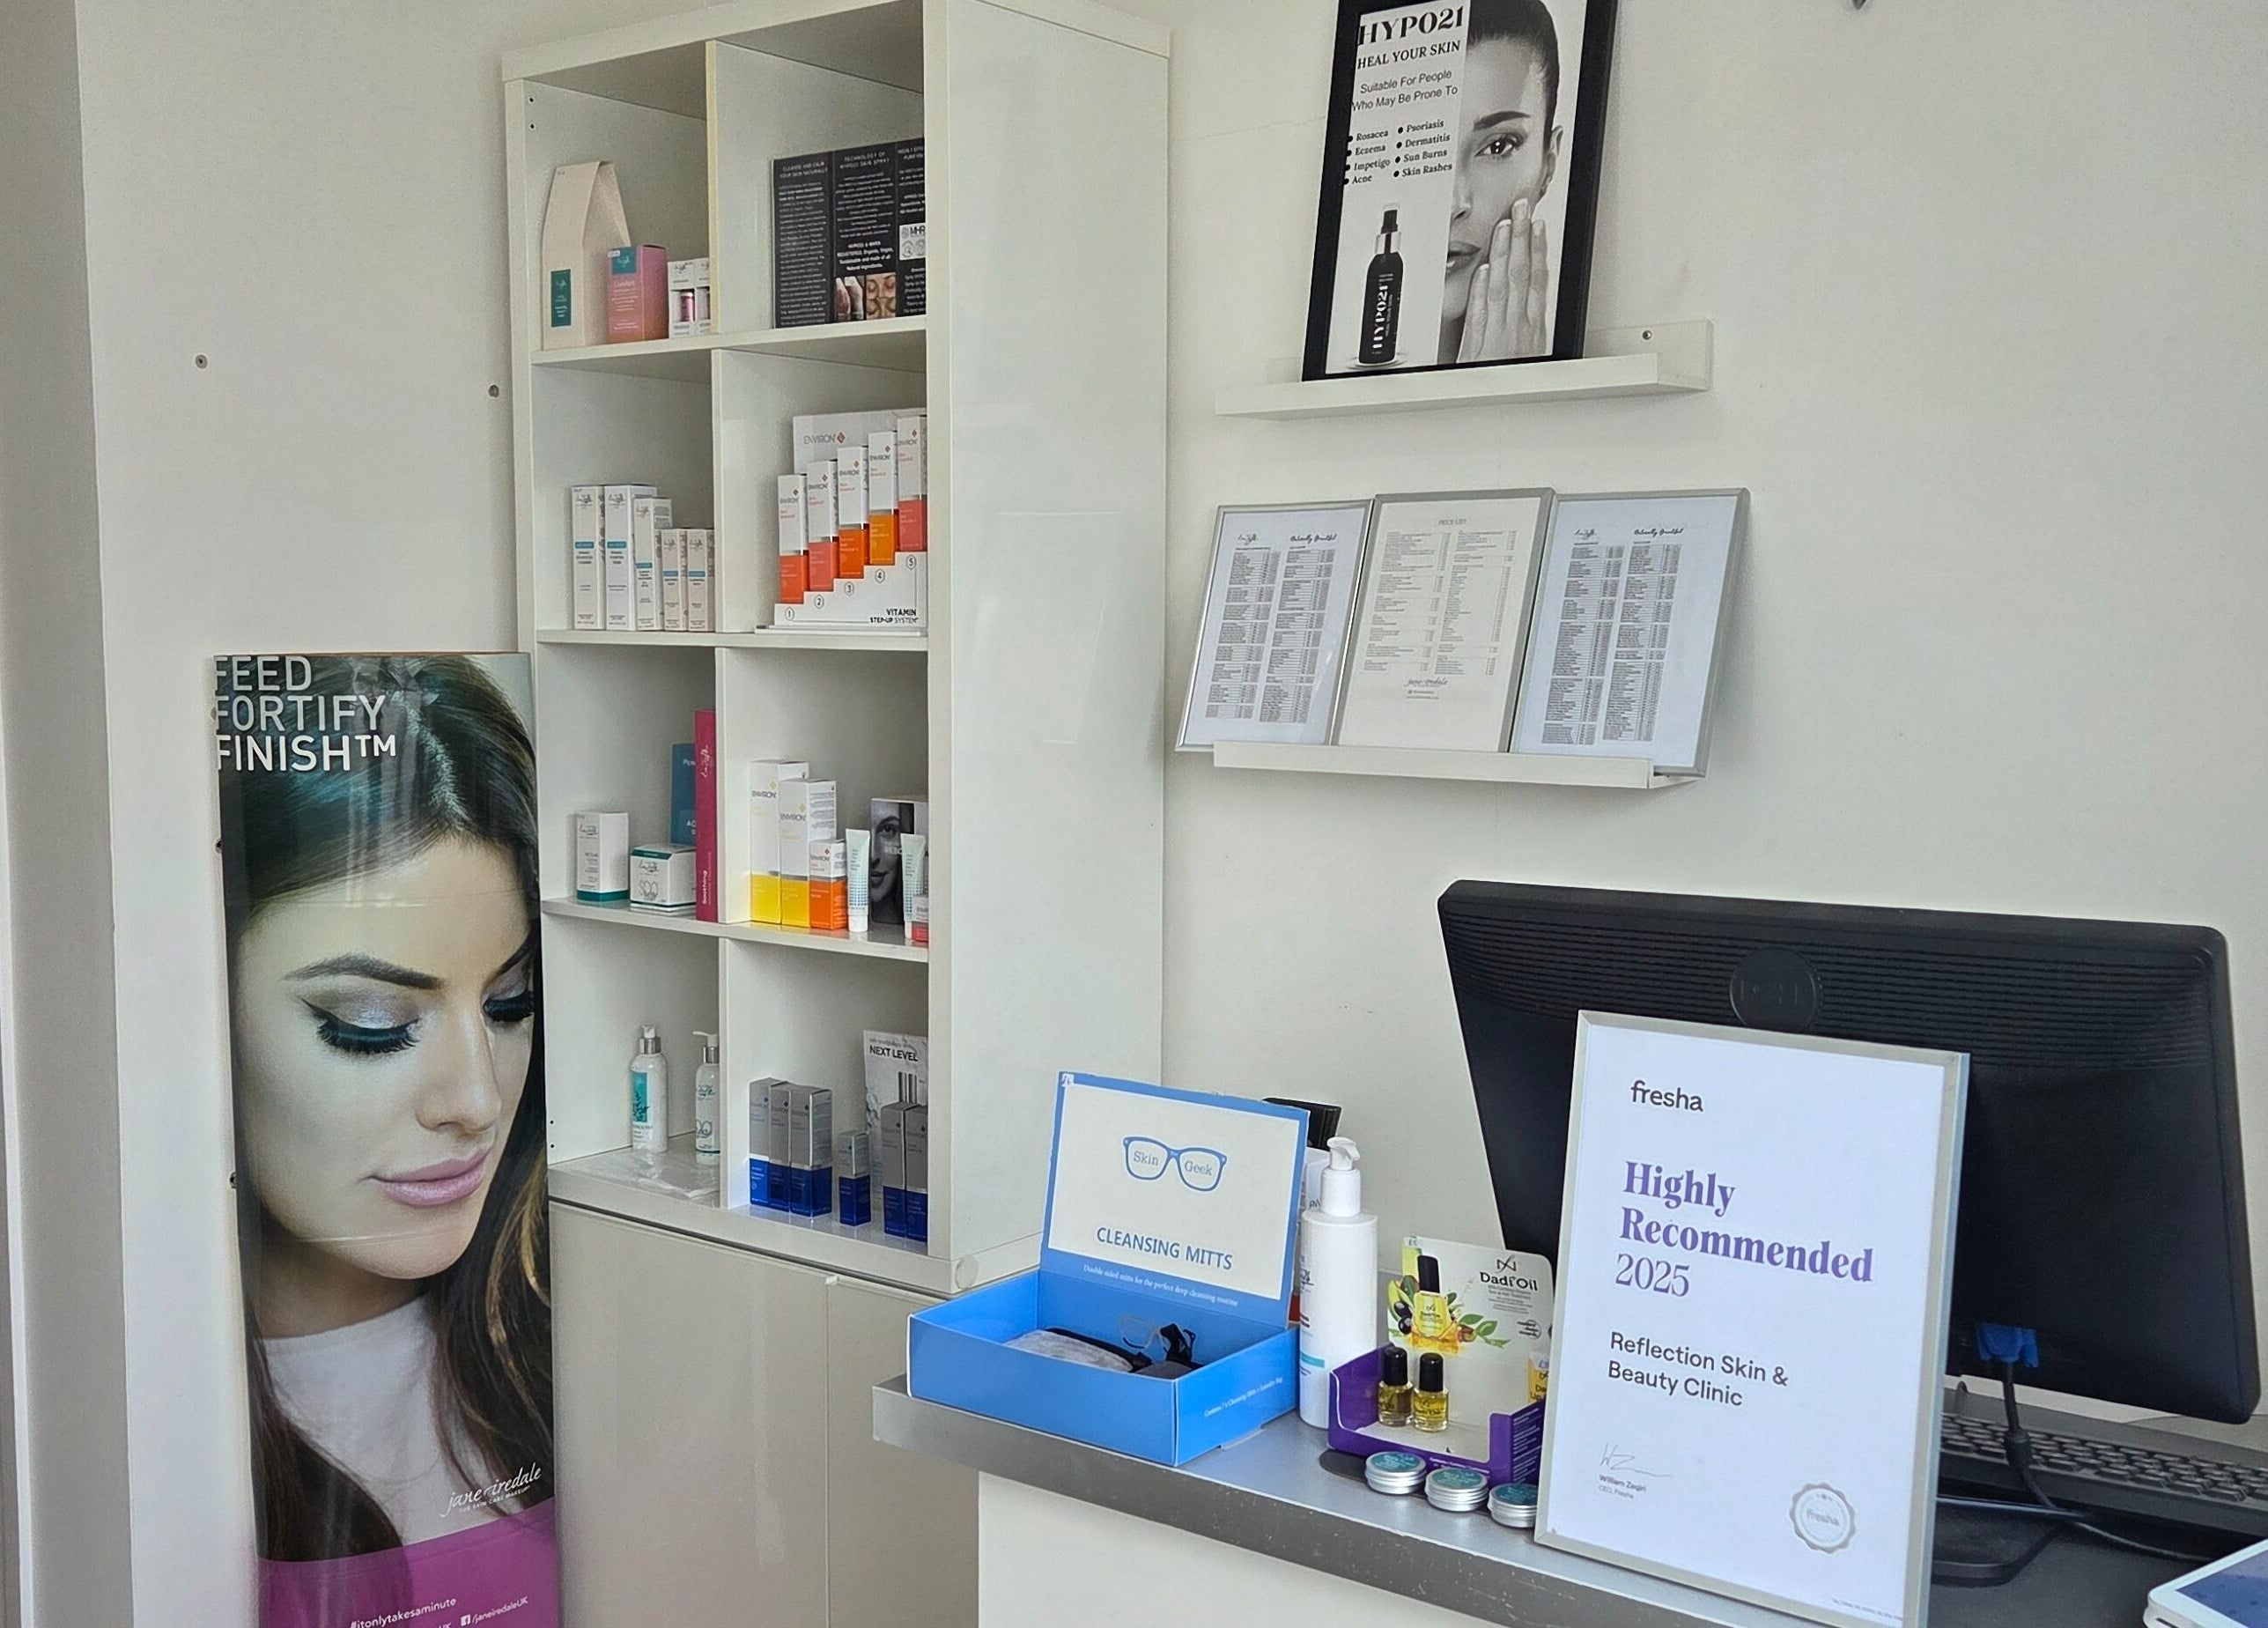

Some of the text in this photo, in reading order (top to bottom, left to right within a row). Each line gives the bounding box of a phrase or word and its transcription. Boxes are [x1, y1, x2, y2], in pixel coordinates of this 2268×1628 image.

[1357, 6, 1464, 46] HYPO21
[1357, 41, 1461, 70] HEAL YOUR SKIN
[1361, 70, 1452, 94] Suitable For People
[1377, 97, 1395, 108] May
[1398, 92, 1411, 104] Be
[1414, 87, 1443, 101] Prone
[1445, 85, 1458, 96] To
[869, 1044, 919, 1062] NEXT LEVEL
[1630, 1079, 1704, 1112] fresha
[1133, 1151, 1214, 1177] Skin Geek
[1623, 1160, 1736, 1217] Highly
[1097, 1227, 1233, 1270] CLEANSING MITTS
[1620, 1206, 1874, 1283] Recommended
[1615, 1254, 1690, 1298] 2025
[1611, 1331, 1789, 1388] Reflection Skin &
[1608, 1360, 1744, 1407] Beauty Clinic
[440, 1462, 542, 1518] jane iredale
